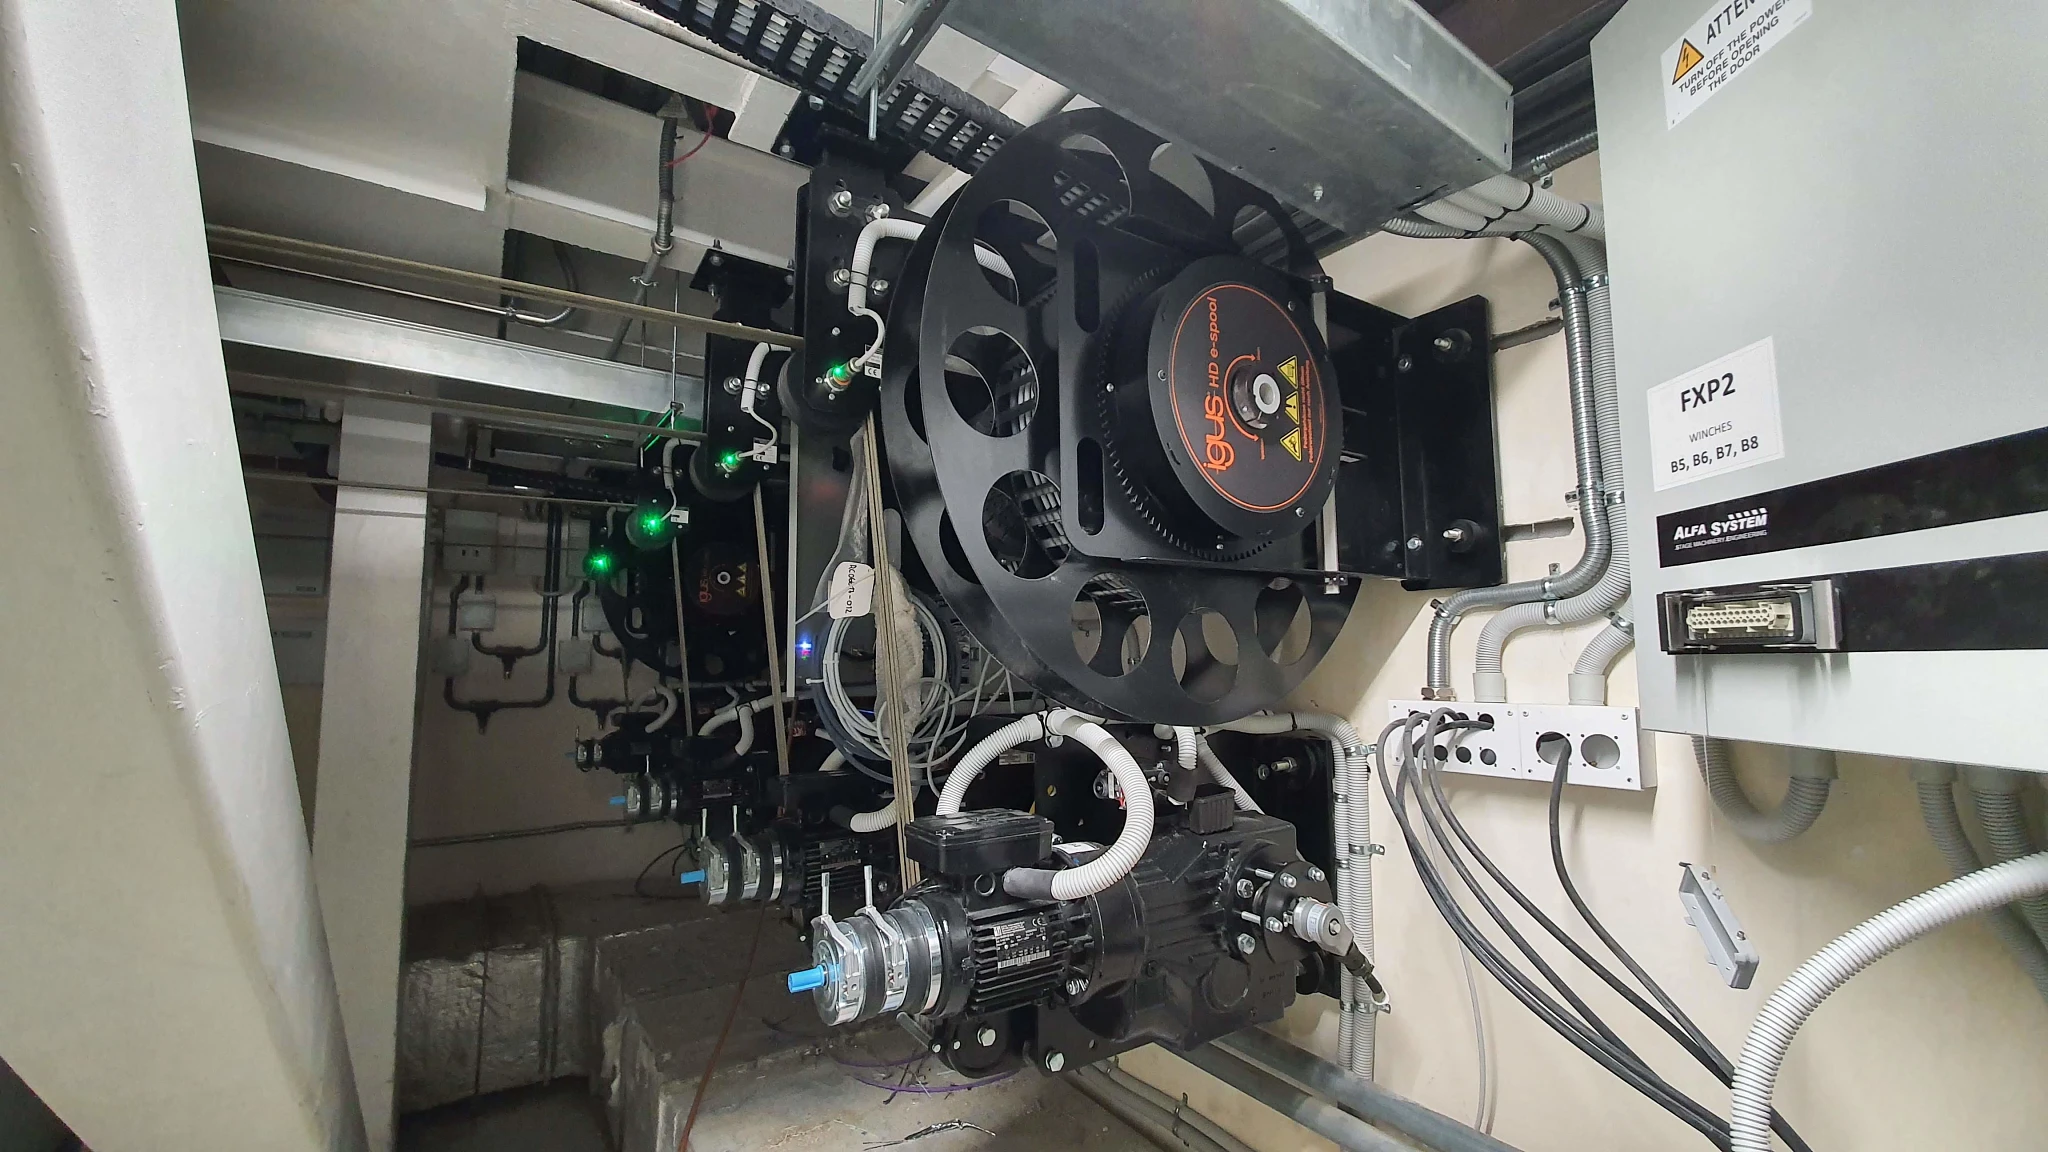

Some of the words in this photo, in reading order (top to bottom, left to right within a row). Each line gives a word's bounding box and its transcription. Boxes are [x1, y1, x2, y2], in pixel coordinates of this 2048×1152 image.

[1678, 67, 1704, 93] TURN
[1705, 48, 1725, 71] OFF
[1726, 30, 1747, 52] THE
[1690, 57, 1729, 96] BEFORE
[1731, 16, 1779, 61] OPENING
[1707, 71, 1728, 92] THE
[1729, 44, 1761, 75] DOOR
[1207, 296, 1220, 359] e-spool
[1208, 362, 1220, 388] HD
[1680, 372, 1736, 413] FXP2
[1203, 394, 1235, 471] igus
[1688, 420, 1733, 443] WINCHES
[1670, 458, 1690, 473] B5,
[1692, 451, 1713, 467] B6,
[1716, 443, 1737, 460] B7,
[1741, 435, 1759, 452] B8
[1673, 523, 1707, 540] ALFA
[1710, 513, 1767, 536] SYSTEM
